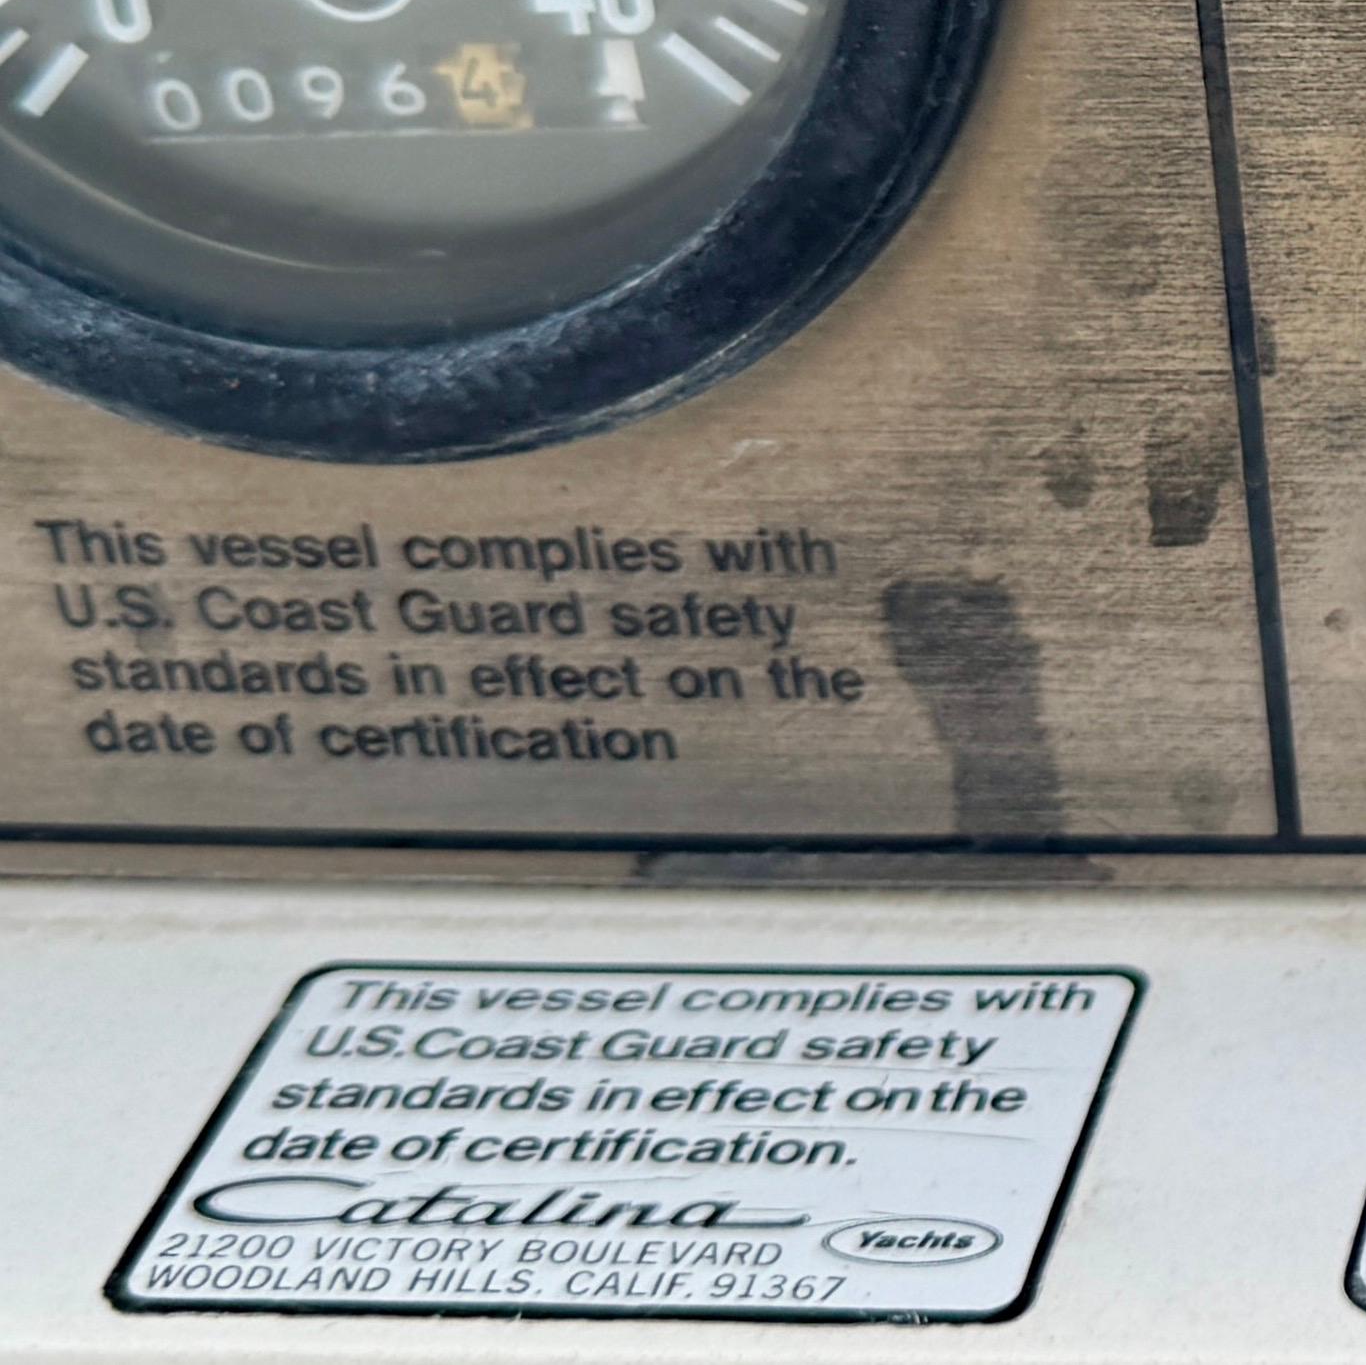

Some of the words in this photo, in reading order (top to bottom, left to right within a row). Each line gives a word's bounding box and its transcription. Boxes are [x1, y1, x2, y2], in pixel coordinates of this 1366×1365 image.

[35, 521, 166, 566] This
[188, 523, 378, 569] vessel
[403, 527, 683, 581] complies
[705, 527, 837, 572] with
[56, 584, 173, 629] U.S.
[199, 586, 372, 632] Coast
[399, 589, 584, 635] Guard
[610, 592, 797, 646] safety
[72, 650, 367, 695] standards
[391, 652, 445, 697] in
[469, 654, 644, 701] effect
[666, 665, 743, 701] on
[768, 657, 864, 704] the
[84, 710, 215, 755] date
[237, 713, 293, 756] of
[320, 714, 678, 762] certification
[342, 979, 461, 1011] This
[476, 981, 672, 1012] vessel
[681, 981, 954, 1017] complies
[973, 981, 1097, 1013] with
[305, 1024, 404, 1058] U.S.
[413, 1026, 592, 1061] Coast
[601, 1027, 790, 1061] Guard
[801, 1028, 999, 1066] safety
[272, 1077, 574, 1112] standards
[584, 1078, 641, 1112] in
[650, 1080, 836, 1113] effect
[845, 1086, 927, 1114] on
[931, 1080, 1029, 1114] the
[242, 1126, 380, 1161] date
[391, 1127, 465, 1162] of
[464, 1128, 858, 1167] certification.
[193, 1174, 811, 1229] Catalina
[158, 1233, 294, 1259] 21200
[315, 1237, 504, 1263] VICTORY
[517, 1239, 783, 1267] BOULEVARD
[859, 1229, 976, 1251] Yachts
[149, 1264, 391, 1292] WOODLAND
[566, 1271, 692, 1299] CALIF.
[709, 1273, 847, 1301] 91367
